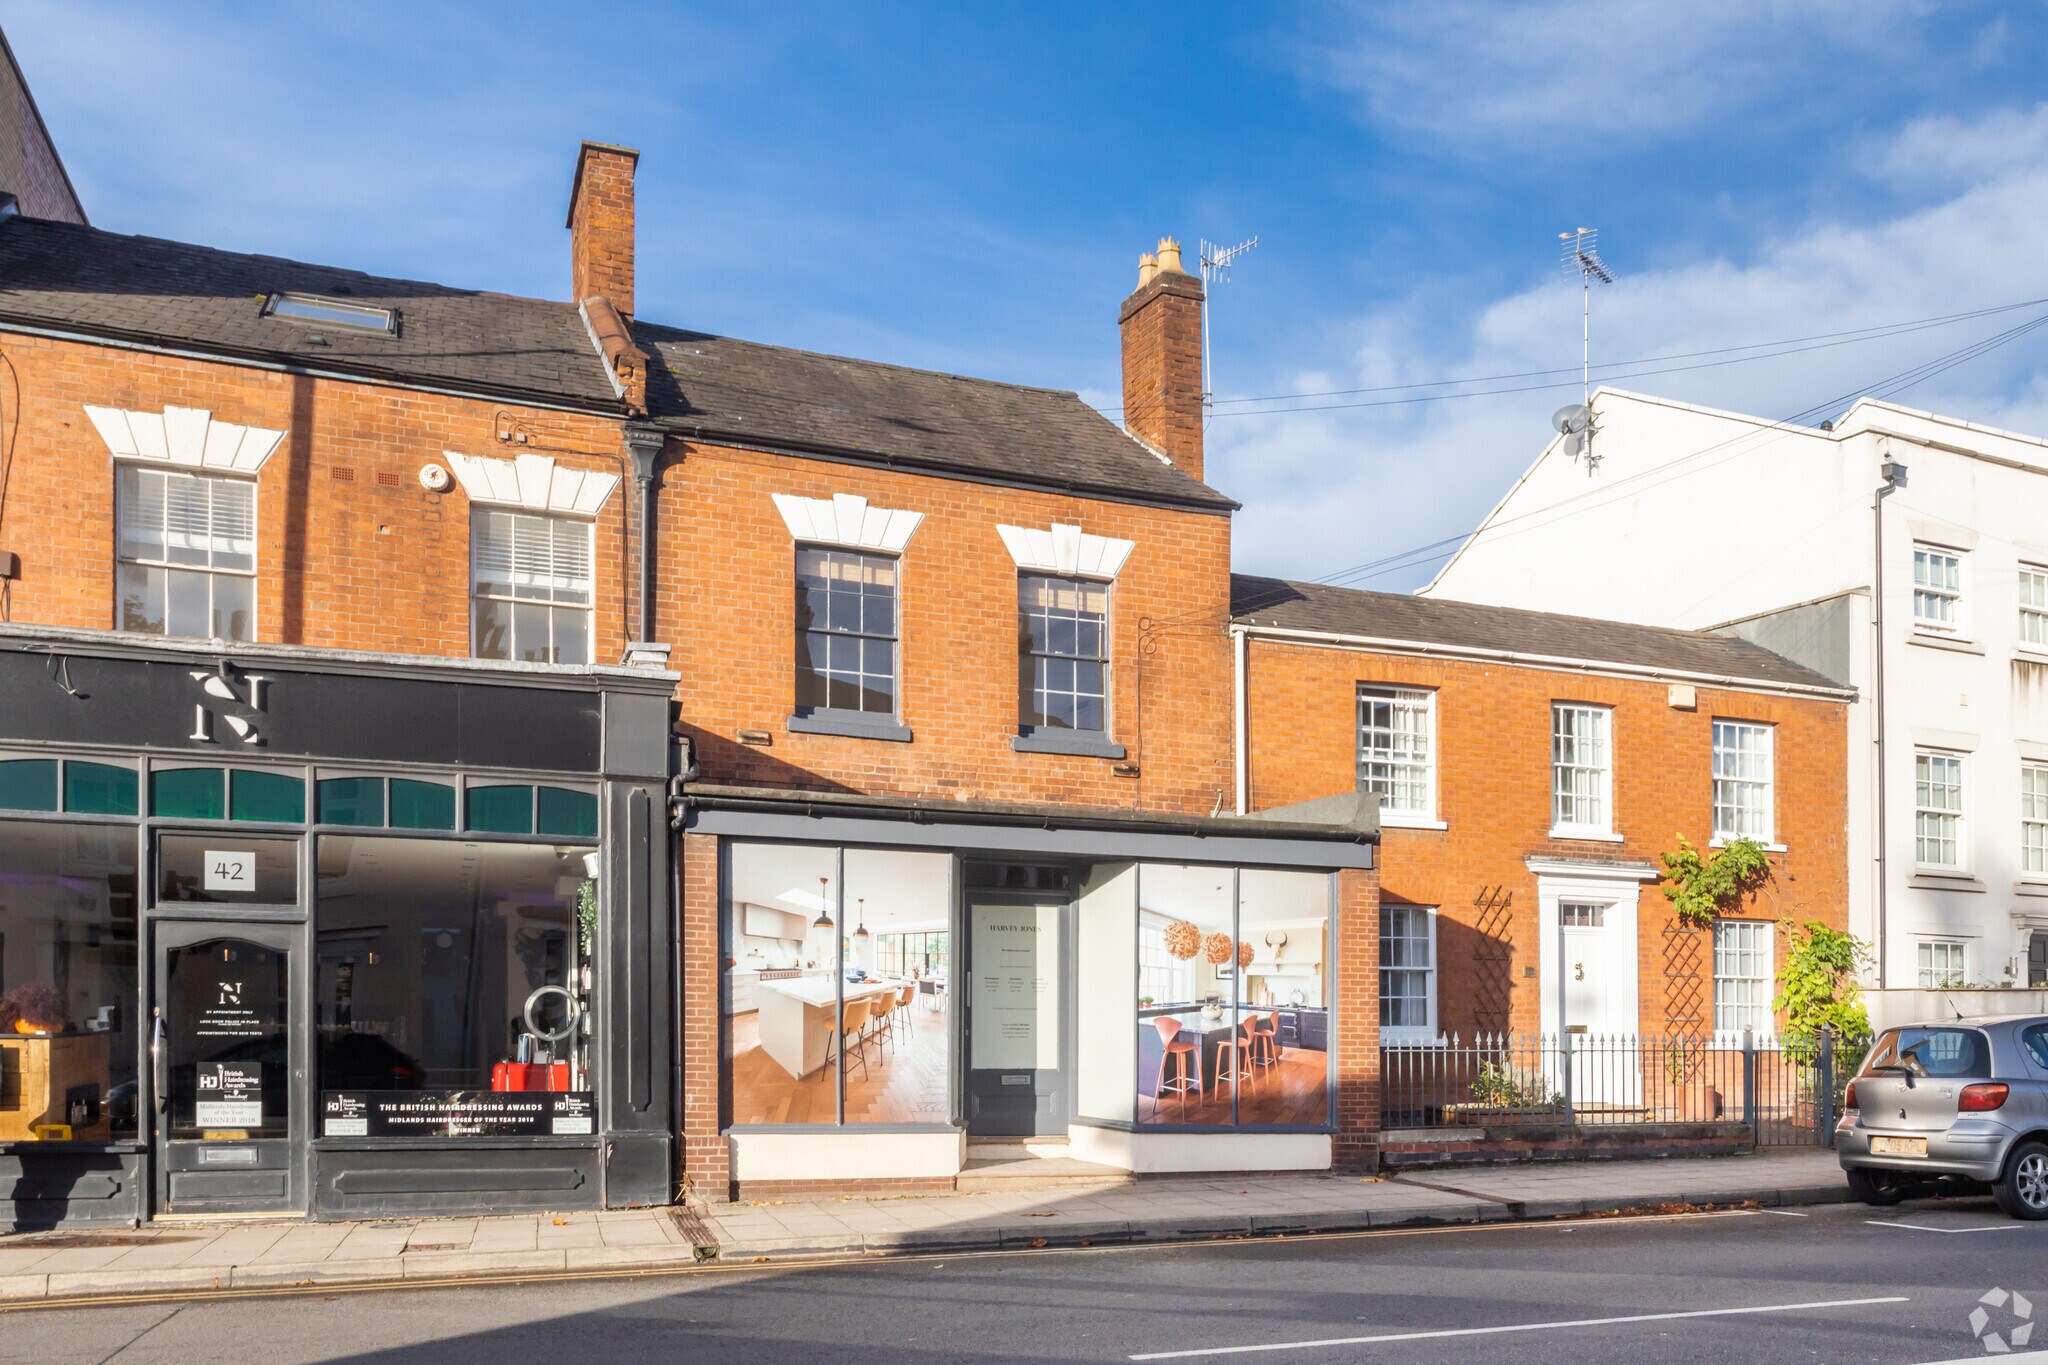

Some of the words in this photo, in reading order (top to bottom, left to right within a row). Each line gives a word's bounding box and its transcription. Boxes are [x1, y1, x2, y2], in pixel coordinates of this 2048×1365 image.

[214, 862, 244, 881] 42
[989, 924, 1018, 932] HARVEY
[1020, 925, 1042, 933] JONES
[200, 1076, 218, 1088] HJ
[224, 1076, 259, 1084] Hairdressing
